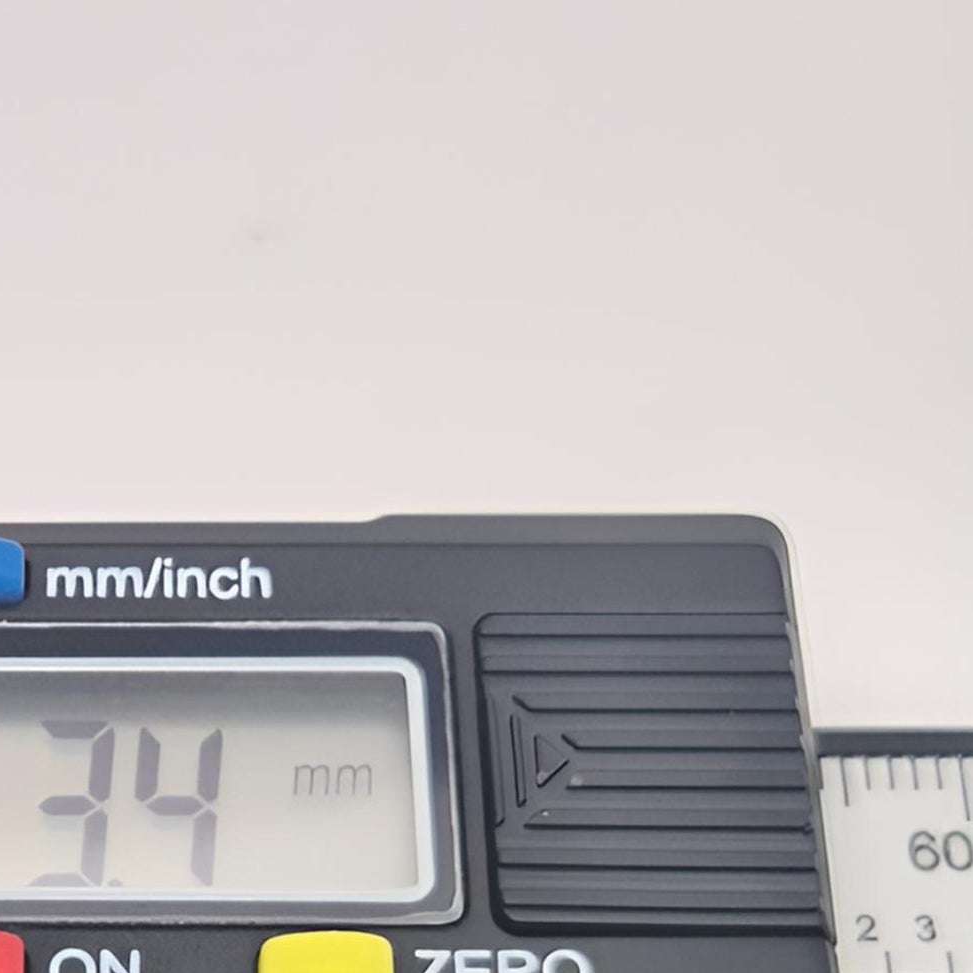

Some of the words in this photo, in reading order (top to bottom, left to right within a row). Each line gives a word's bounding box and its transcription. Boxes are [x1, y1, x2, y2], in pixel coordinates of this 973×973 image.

[45, 557, 274, 602] mm/inch
[292, 763, 373, 796] mm
[910, 831, 973, 871] 60
[855, 915, 878, 941] 2
[915, 915, 937, 942] 3
